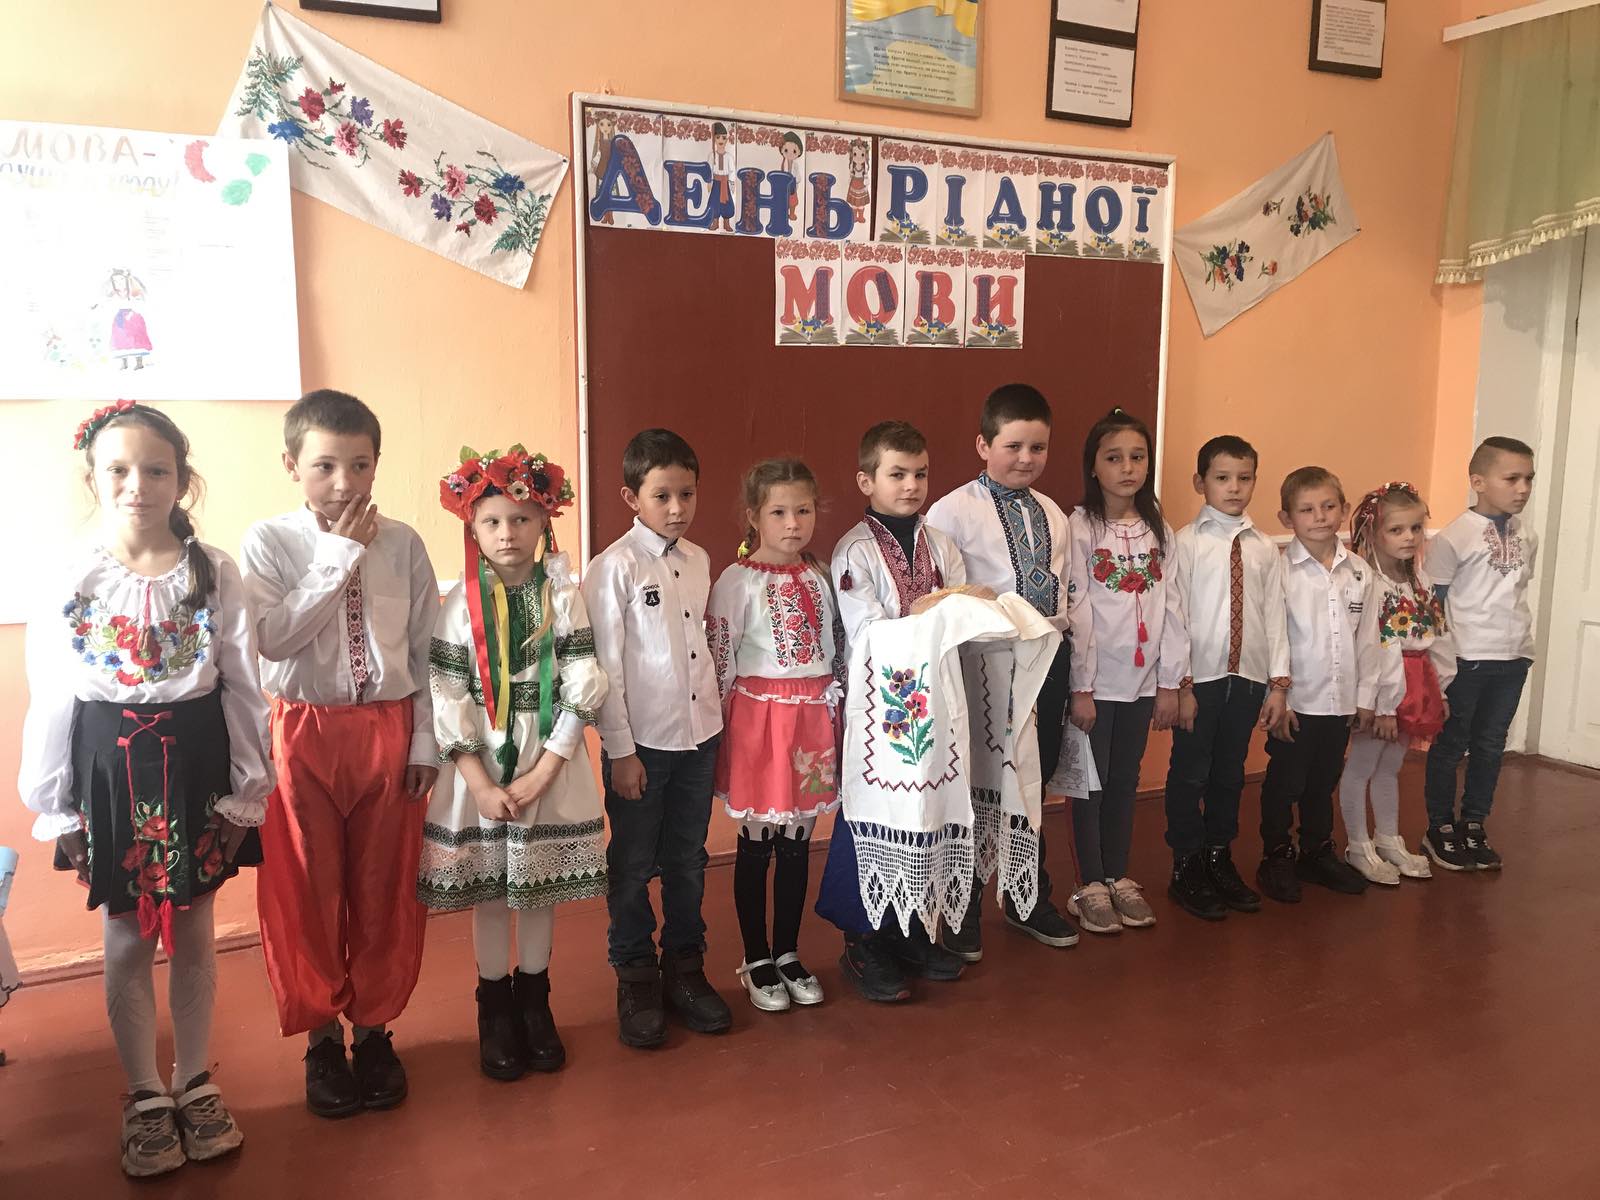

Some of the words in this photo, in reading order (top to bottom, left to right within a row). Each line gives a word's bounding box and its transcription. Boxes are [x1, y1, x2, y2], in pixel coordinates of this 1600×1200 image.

[589, 134, 855, 240] ДЕНЬ
[886, 164, 1158, 235] РІДНОЇ
[780, 264, 1018, 328] МОВИ
